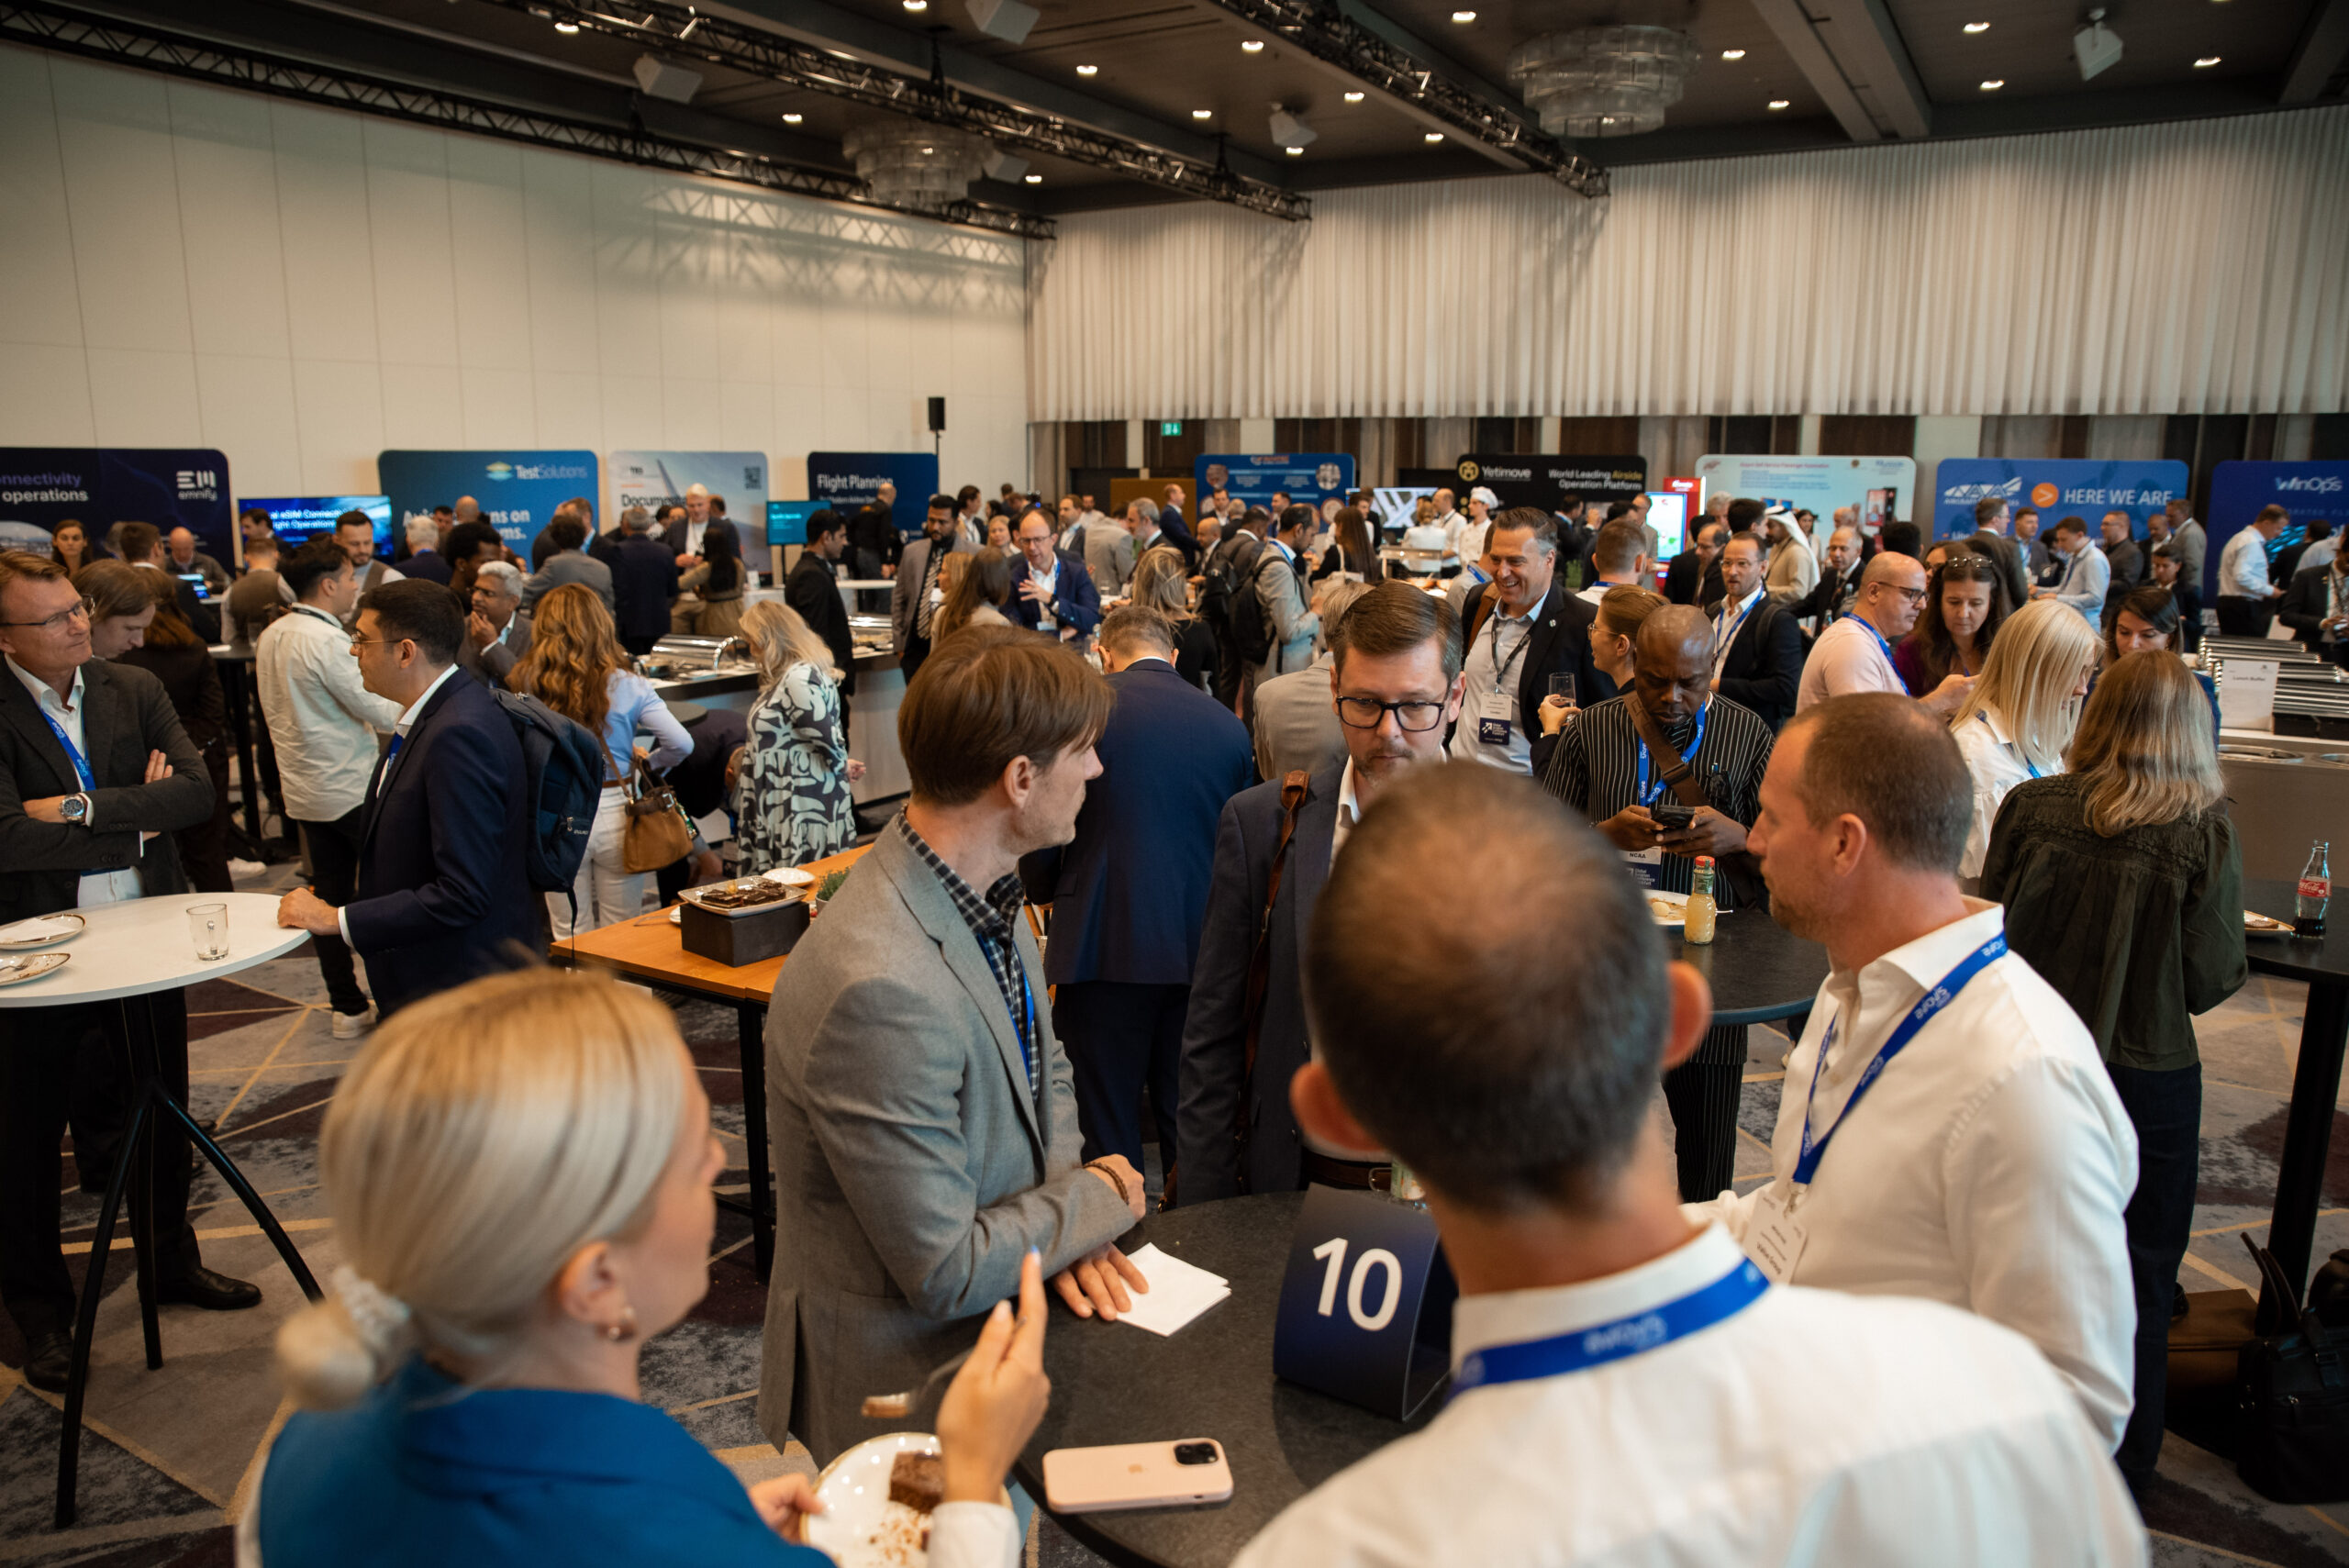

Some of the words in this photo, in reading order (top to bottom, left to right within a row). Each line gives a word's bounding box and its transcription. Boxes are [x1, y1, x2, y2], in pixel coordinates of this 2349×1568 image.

[0, 472, 82, 488] nnectivity
[817, 473, 849, 493] Flight
[2, 487, 89, 505] operations
[2064, 488, 2106, 505] HERE
[2108, 489, 2136, 506] WE
[2137, 490, 2173, 506] ARE
[509, 509, 530, 522] on
[1313, 1238, 1402, 1331] 10
